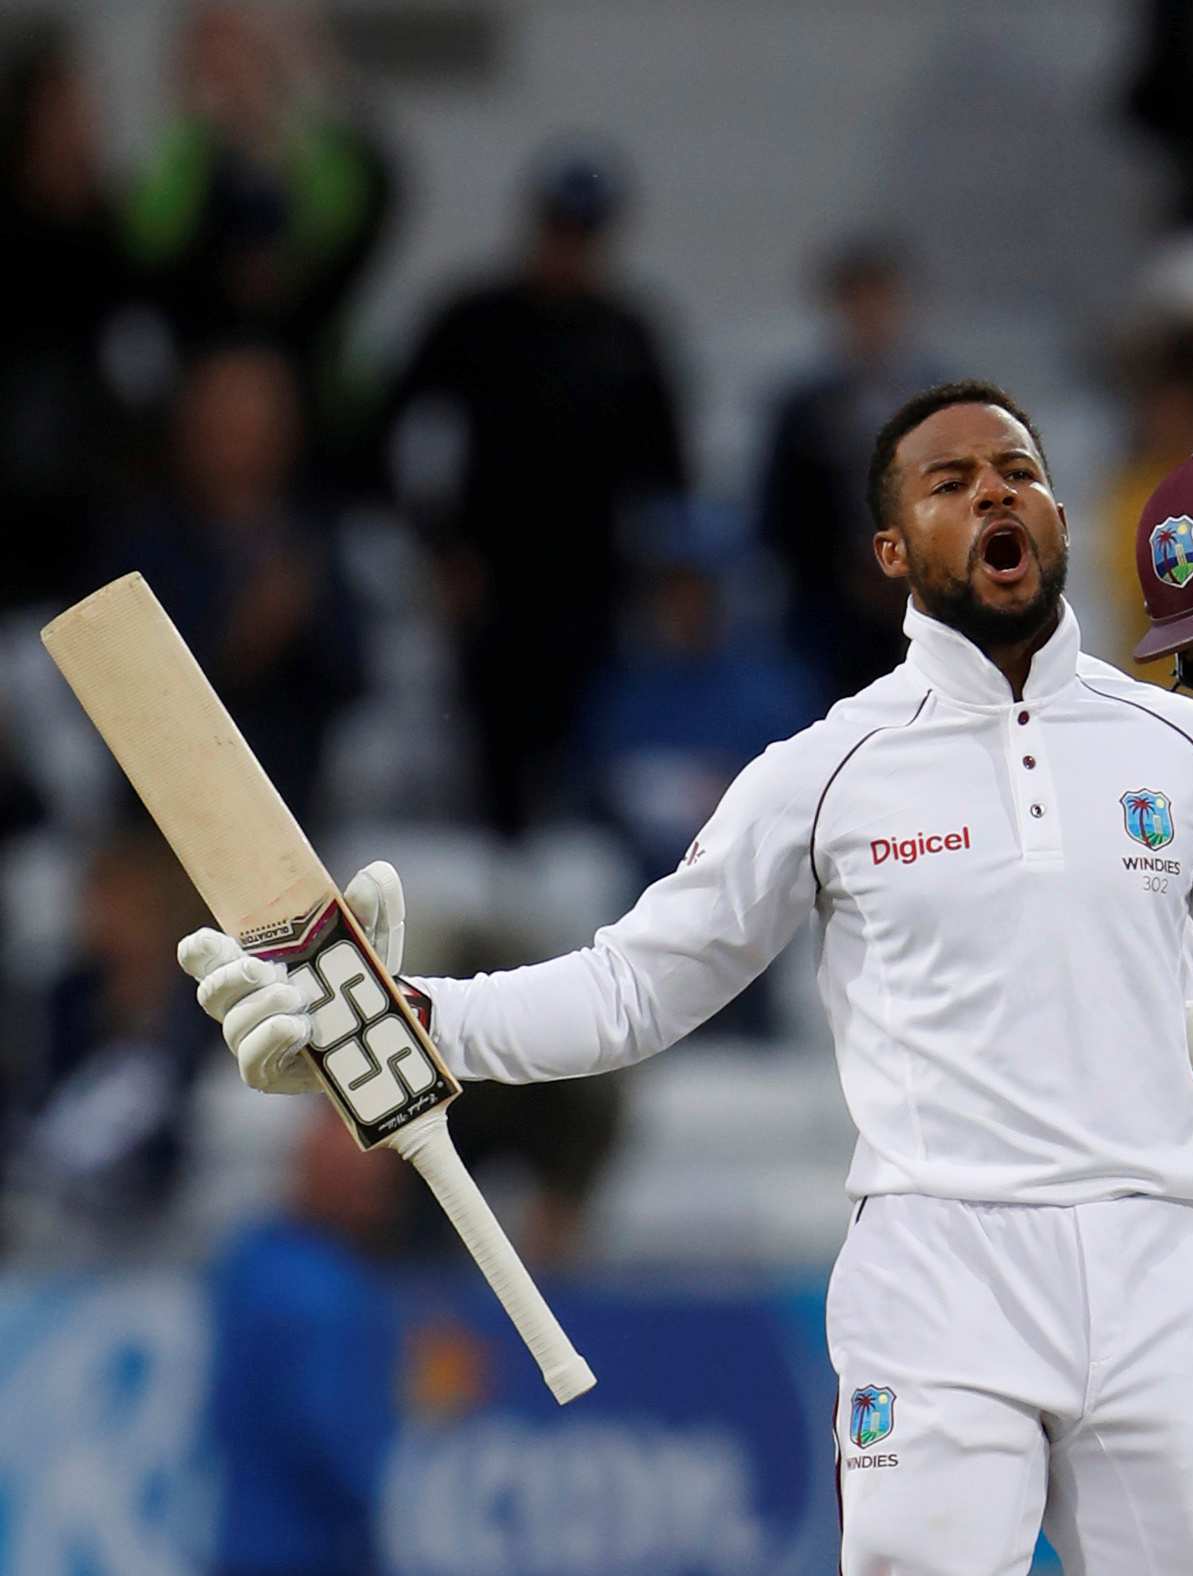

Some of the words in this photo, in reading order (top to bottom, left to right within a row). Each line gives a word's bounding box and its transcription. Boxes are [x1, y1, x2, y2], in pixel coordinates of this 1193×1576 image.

[870, 827, 970, 865] Digicel
[1121, 857, 1180, 876] WINDIES
[1143, 876, 1169, 894] 302
[289, 940, 435, 1125] SS
